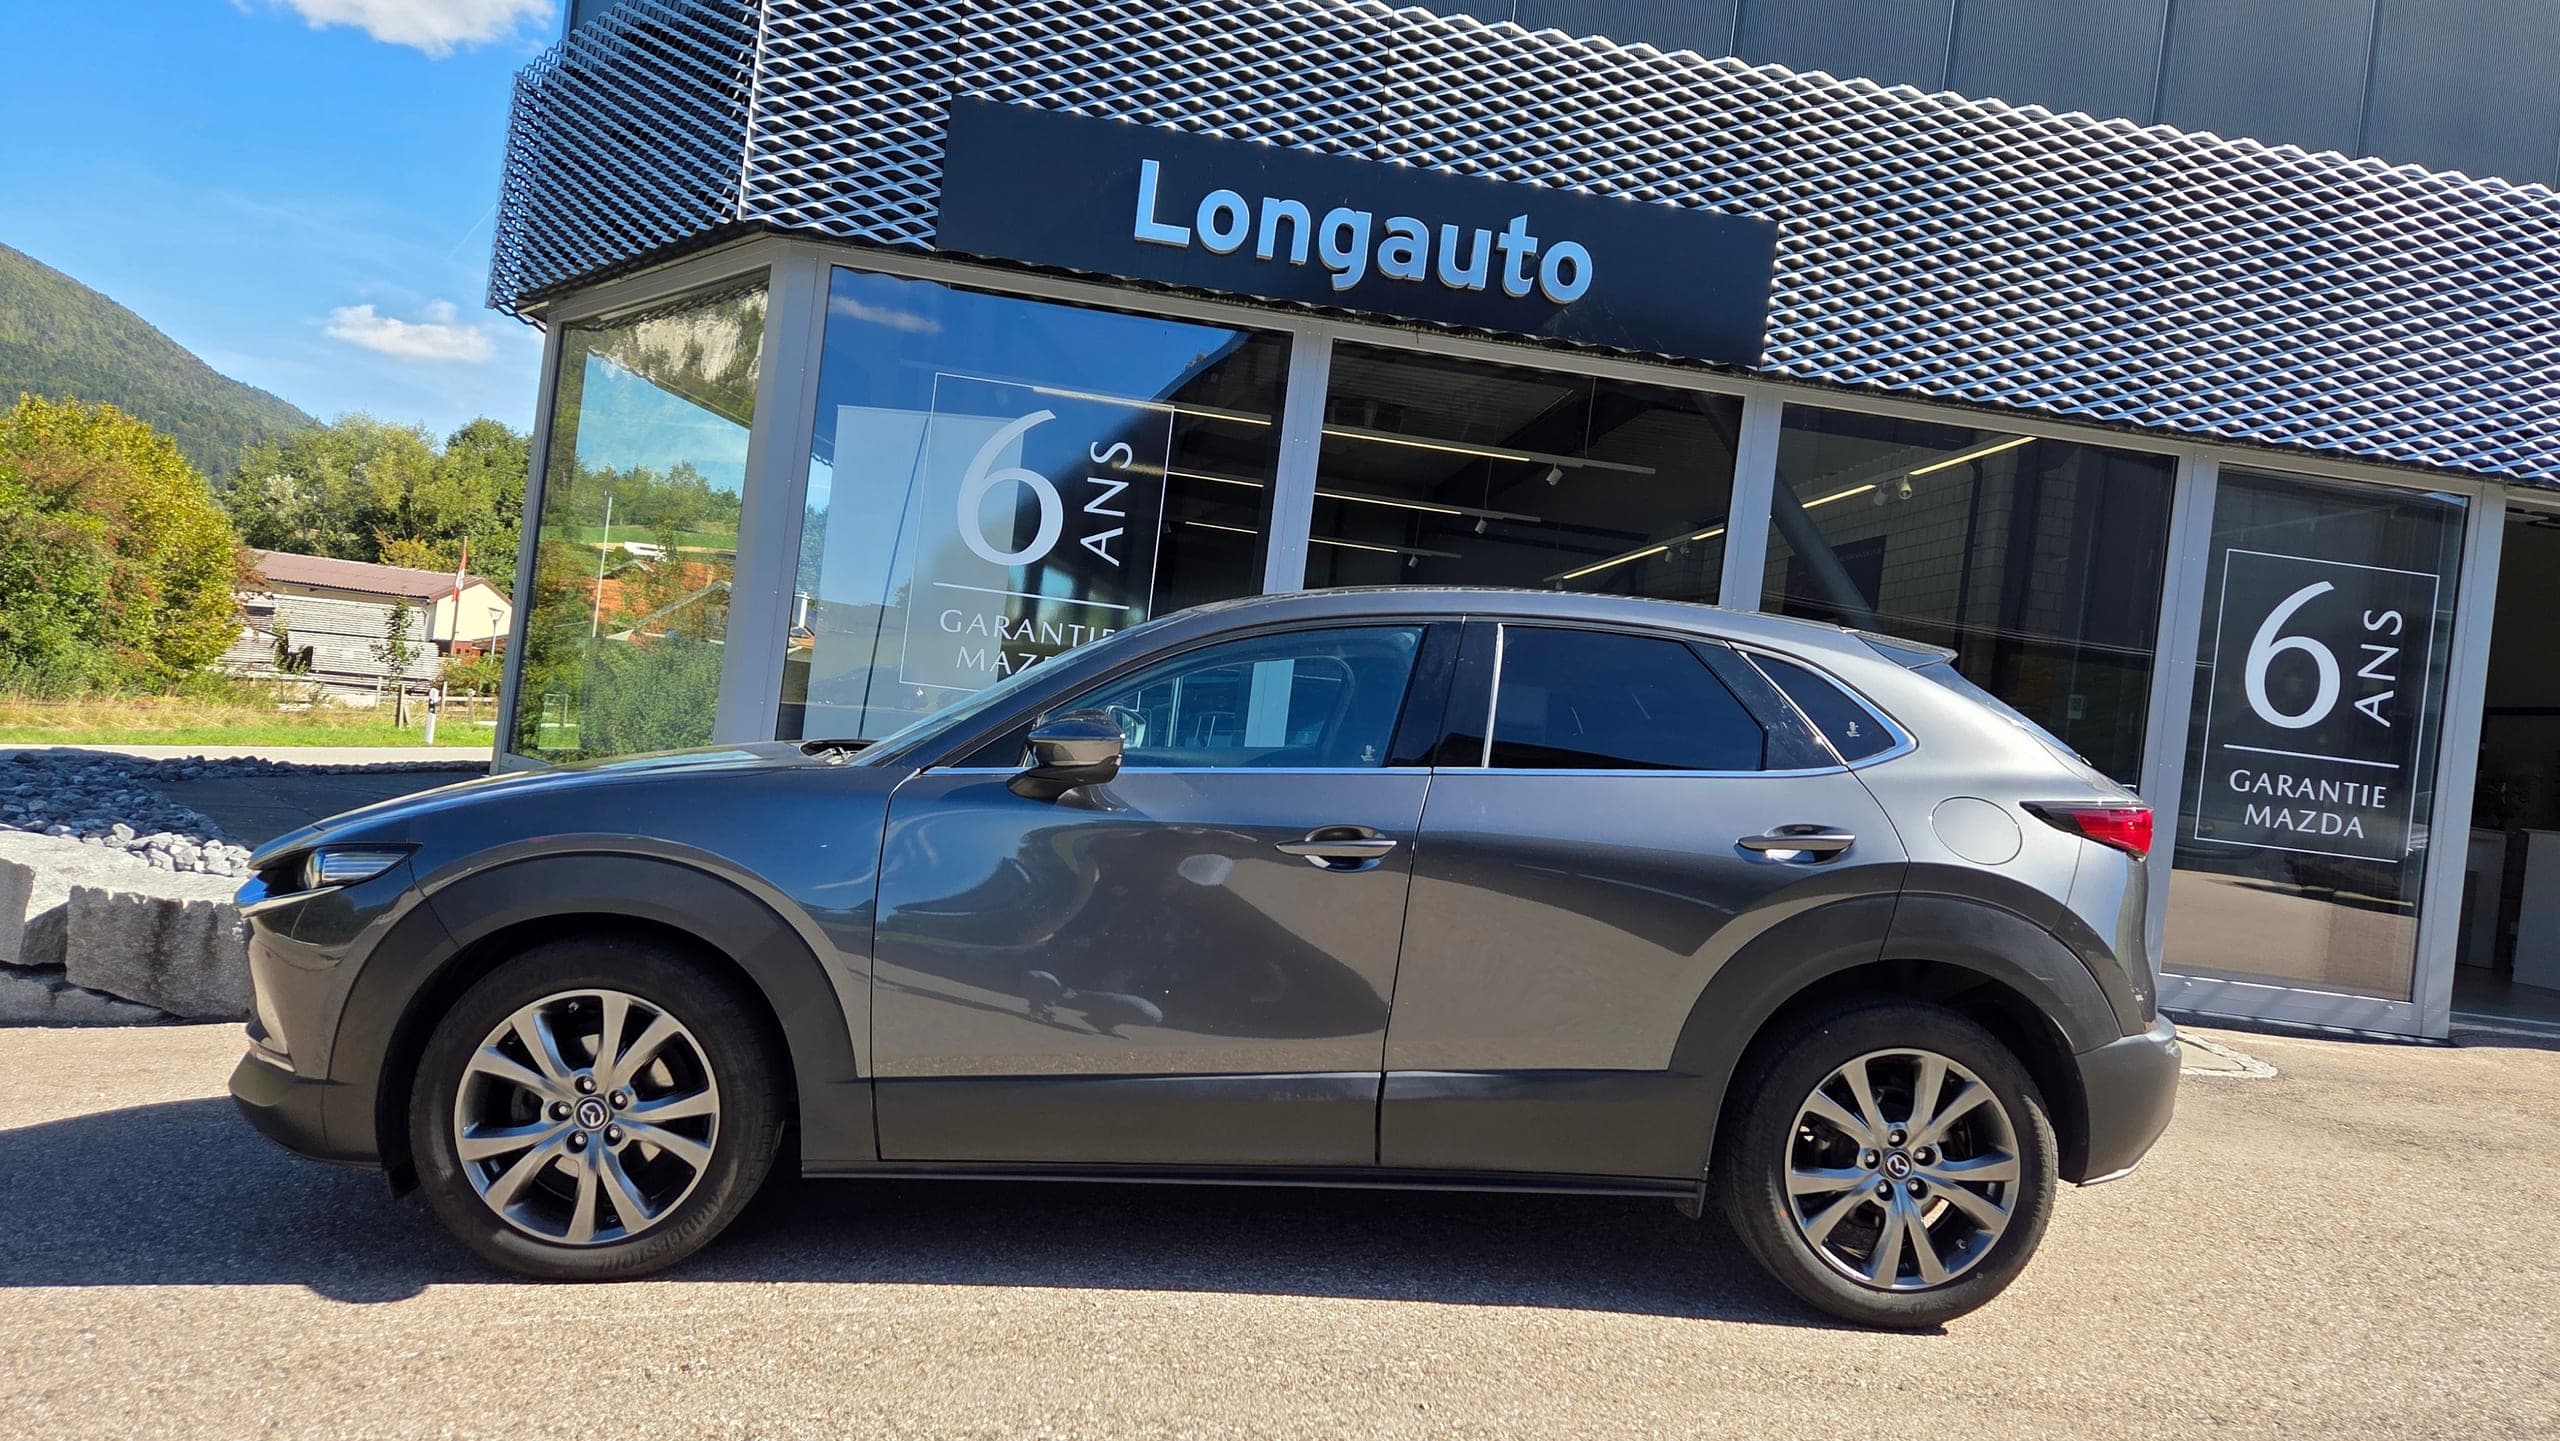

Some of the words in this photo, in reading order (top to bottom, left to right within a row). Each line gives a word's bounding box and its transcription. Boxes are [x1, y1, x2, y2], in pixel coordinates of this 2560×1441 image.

[1134, 157, 1594, 305] Longauto
[957, 409, 1064, 566] 6
[1080, 441, 1134, 567] ANS
[955, 645, 1055, 676] MAZ
[2244, 580, 2341, 729] 6
[2354, 610, 2403, 728] ANS
[2229, 768, 2387, 809] GARANTIE
[2244, 803, 2365, 839] MAZDA
